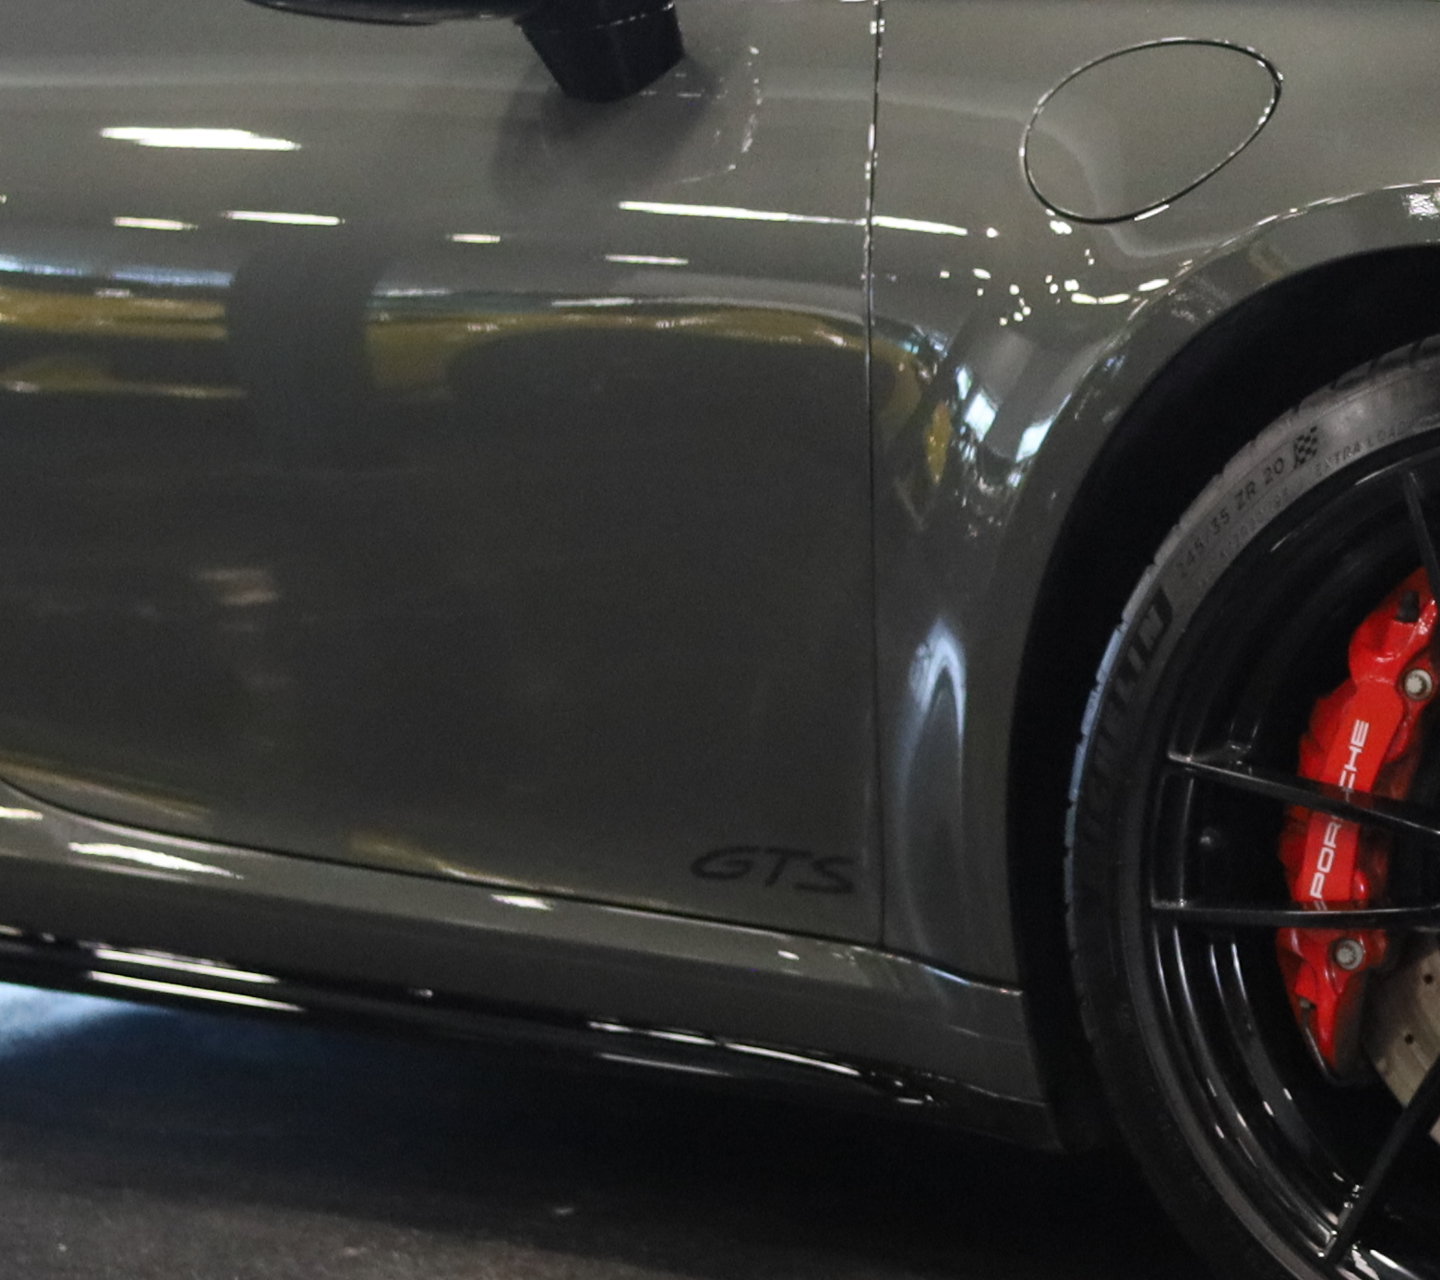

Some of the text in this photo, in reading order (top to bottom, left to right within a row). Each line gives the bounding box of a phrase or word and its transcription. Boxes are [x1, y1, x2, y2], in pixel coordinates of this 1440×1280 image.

[1232, 480, 1258, 511] ZR
[1262, 457, 1286, 486] 20
[1310, 719, 1370, 899] PORCHE
[690, 845, 855, 894] GTS
